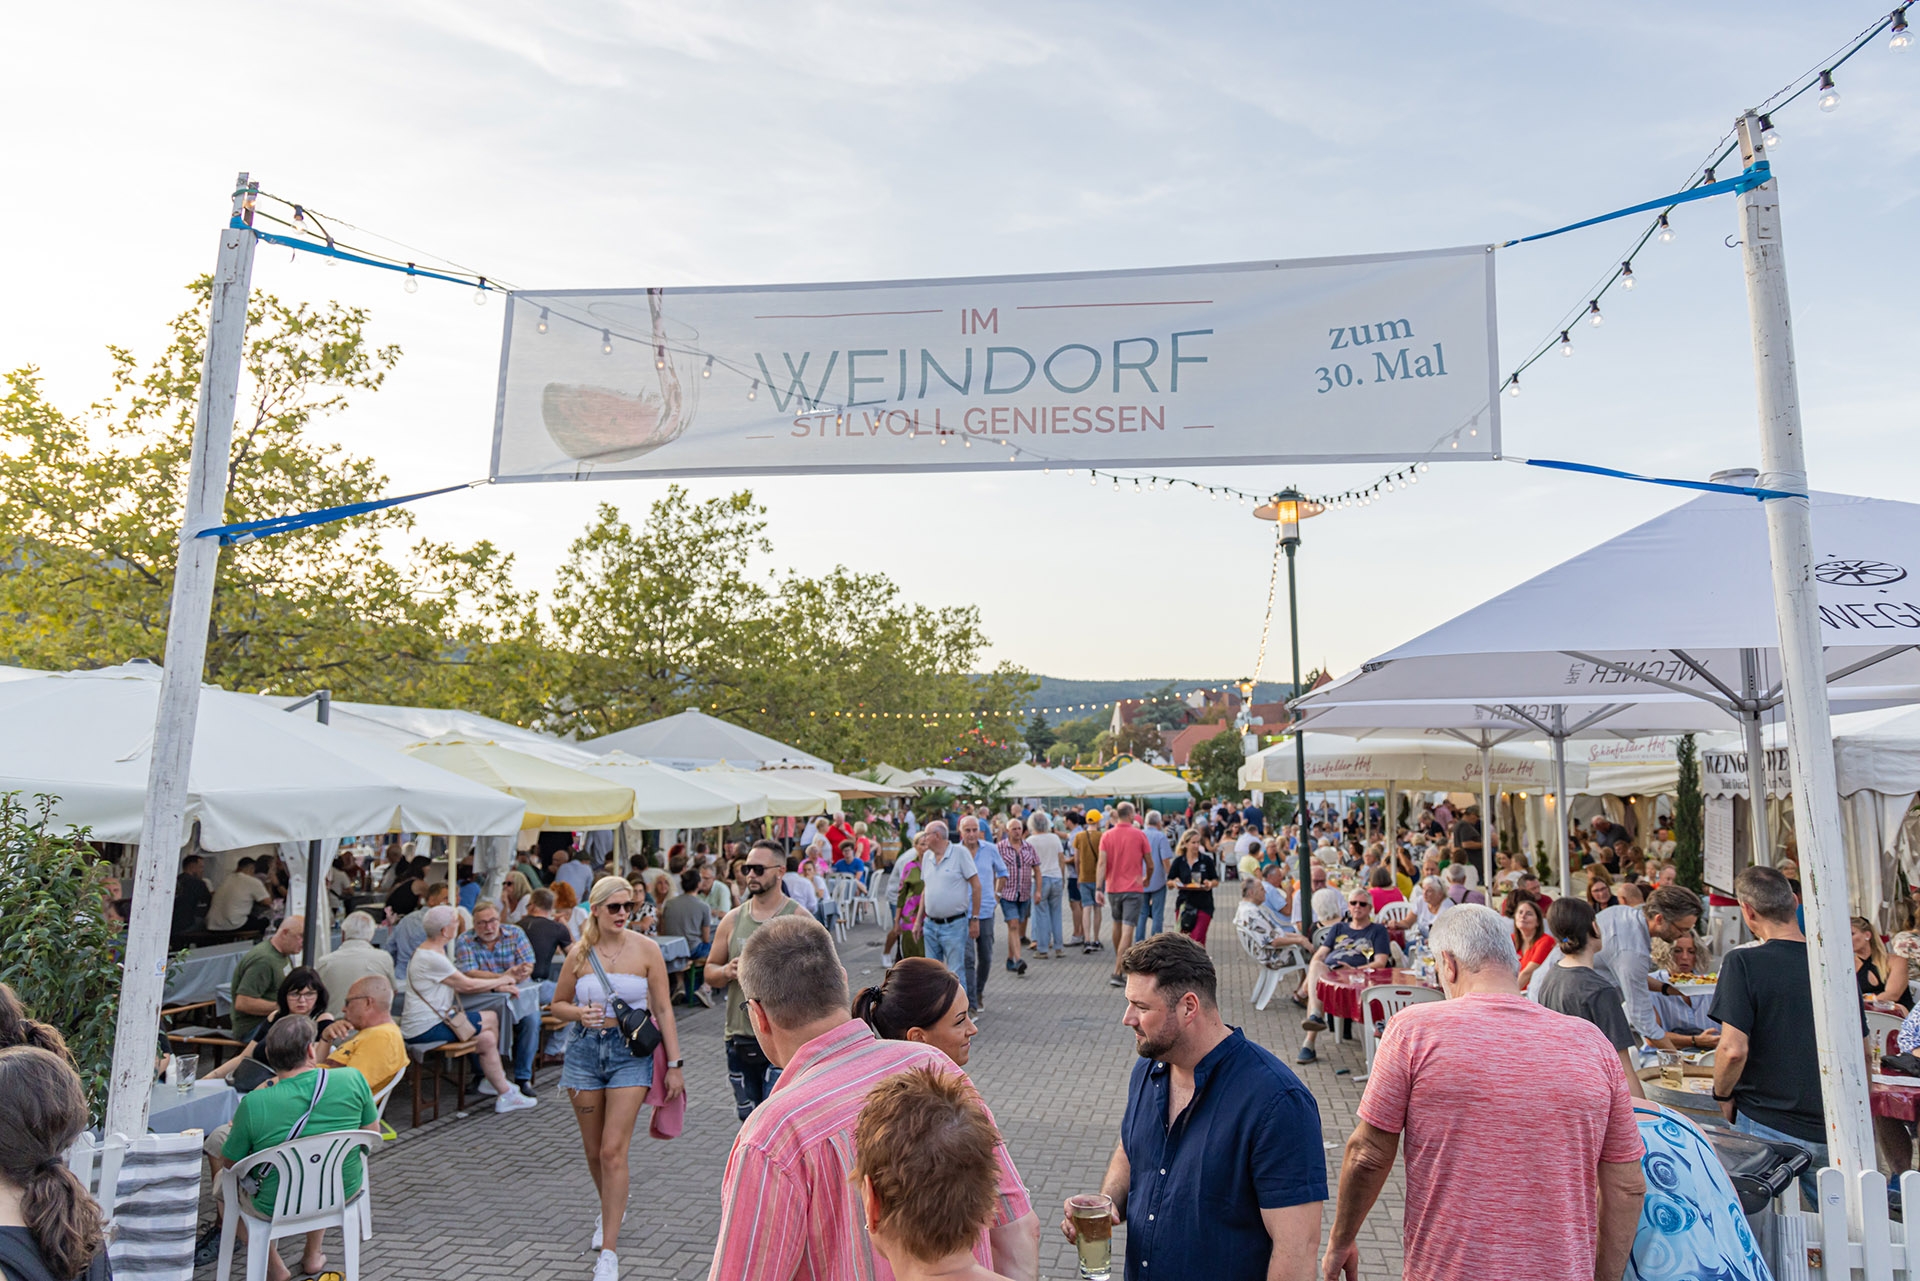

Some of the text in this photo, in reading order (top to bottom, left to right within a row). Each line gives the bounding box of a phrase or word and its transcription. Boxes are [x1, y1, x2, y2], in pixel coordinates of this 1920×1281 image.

[961, 307, 998, 335] IM
[1328, 317, 1415, 350] zum
[754, 328, 1214, 413] WEINDORF
[1314, 342, 1448, 394] 30. Mal
[790, 405, 1165, 438] STILVOLL GENIESSEN
